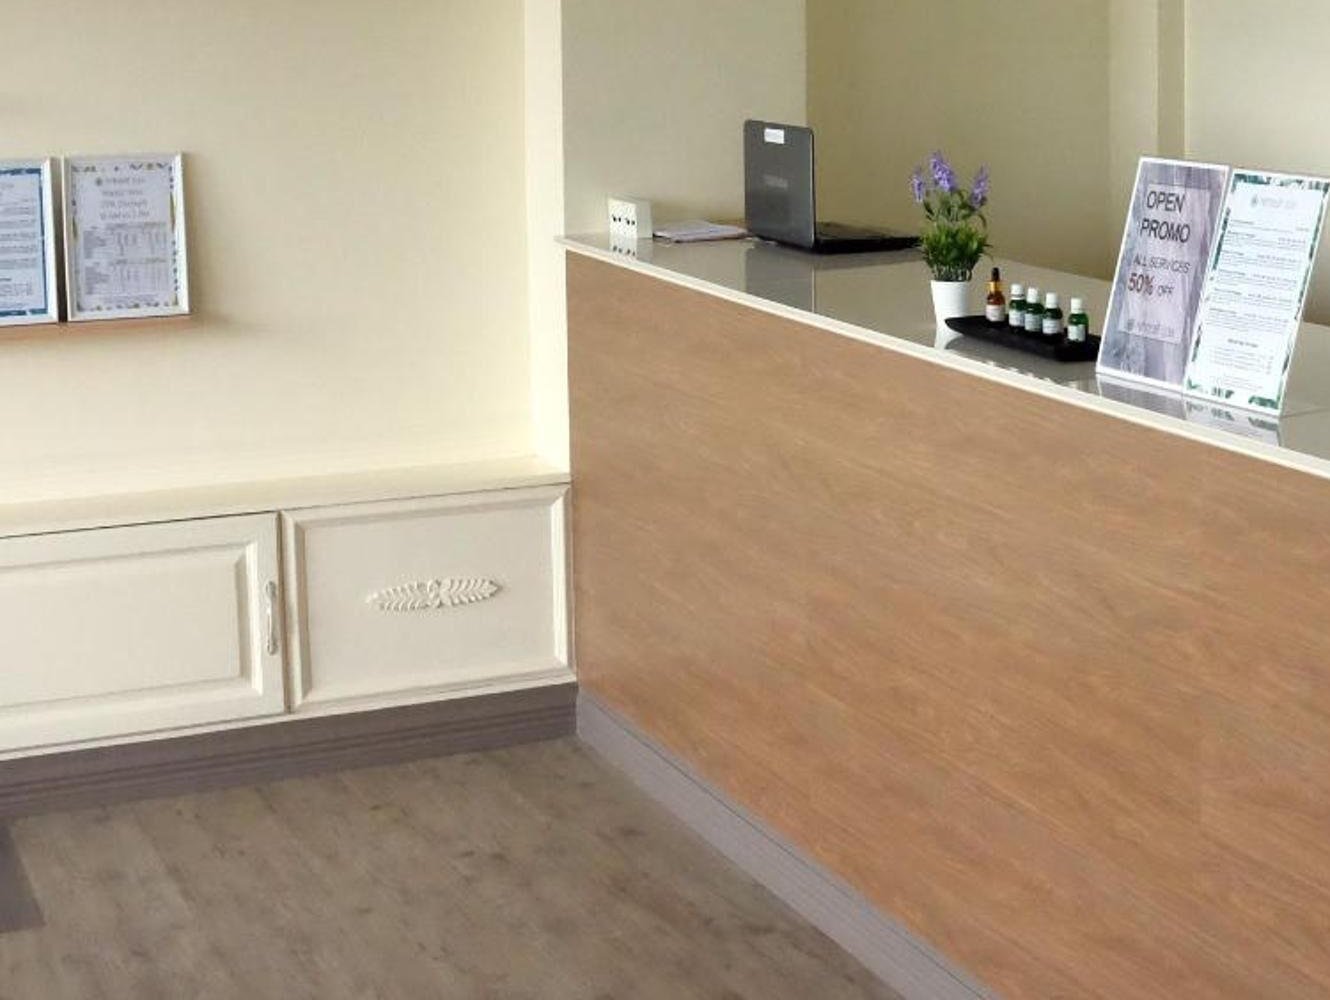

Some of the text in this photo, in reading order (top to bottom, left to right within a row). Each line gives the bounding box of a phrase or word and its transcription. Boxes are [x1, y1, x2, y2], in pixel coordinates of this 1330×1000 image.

[1146, 190, 1186, 213] OPEN
[1140, 218, 1191, 243] PROMO
[1127, 272, 1155, 296] 50%
